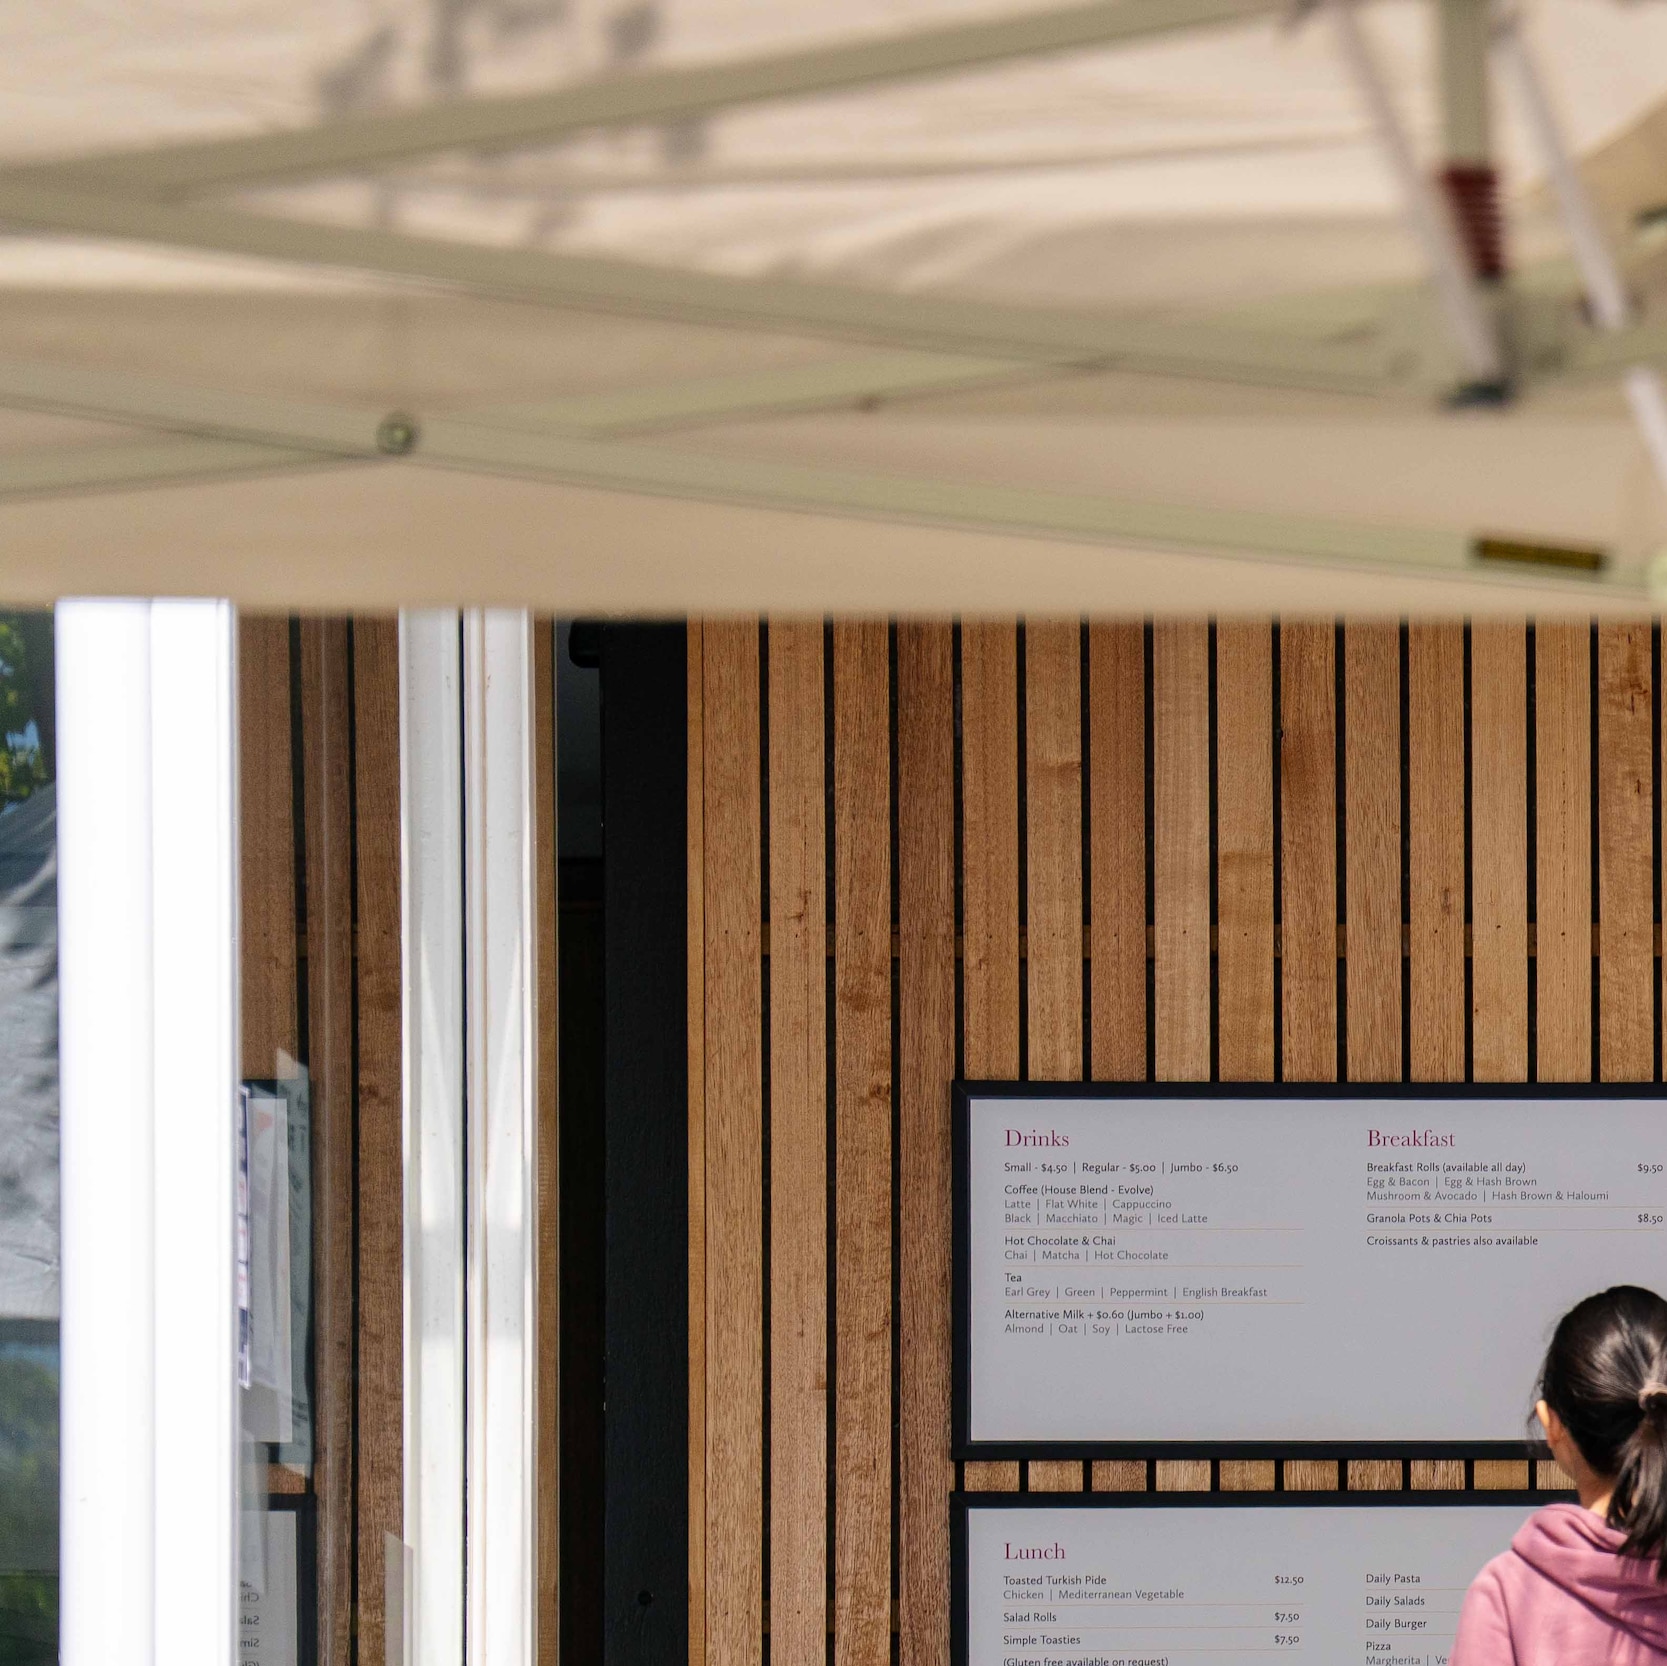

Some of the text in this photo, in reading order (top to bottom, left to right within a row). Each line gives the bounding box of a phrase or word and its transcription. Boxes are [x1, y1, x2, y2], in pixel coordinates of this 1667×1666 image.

[1006, 1129, 1069, 1147] Drinks
[1368, 1129, 1454, 1147] Breakfast
[1004, 1162, 1239, 1175] Small $4.50 Regular $5.00 Jumbo $6.50
[1367, 1161, 1526, 1174] Breakfast Rolls (available all day)
[1637, 1163, 1664, 1174] $9.50
[1367, 1176, 1537, 1189] Egg Bacon Egg Hash Brown
[1004, 1184, 1154, 1196] Coffee (House Blend Evolve)
[1367, 1190, 1609, 1201] Mushroom Avocado Hash Brown Haloumi
[1004, 1199, 1172, 1211] Latte Flat White Cappuccino
[1005, 1213, 1208, 1226] Black Macchiato Magic Iced Latte
[1366, 1213, 1492, 1223] Granola Pots Chia Pots
[1637, 1213, 1663, 1225] $8.50
[1005, 1235, 1116, 1246] Hot Chocolate Chai
[1366, 1235, 1538, 1248] Croissants pastries also available
[1004, 1272, 1022, 1282] Tea
[1005, 1286, 1268, 1300] Earl Grey Green Peppermint English Breakfast
[1004, 1309, 1204, 1321] Alternative Milk $0.60 (Jumbo $1.00)
[1005, 1542, 1065, 1560] Lunch
[1003, 1575, 1107, 1586] Toasted Turkish Pide
[1274, 1575, 1304, 1586] $12.50
[1366, 1573, 1421, 1586] Daily Pasta
[1003, 1588, 1184, 1602] Chicken Mediterranean Vegetable
[1366, 1595, 1425, 1608] Daily Salads
[1003, 1612, 1057, 1622] Salad Rolls
[1274, 1612, 1300, 1623] $7.50
[1366, 1618, 1427, 1631] Daily Burger
[1003, 1635, 1081, 1647] Simple Toasties
[1274, 1634, 1300, 1646] $7.50
[1366, 1641, 1391, 1651] Pizza
[1043, 1657, 1063, 1666] free
[1066, 1657, 1109, 1666] available
[1112, 1659, 1125, 1666] on
